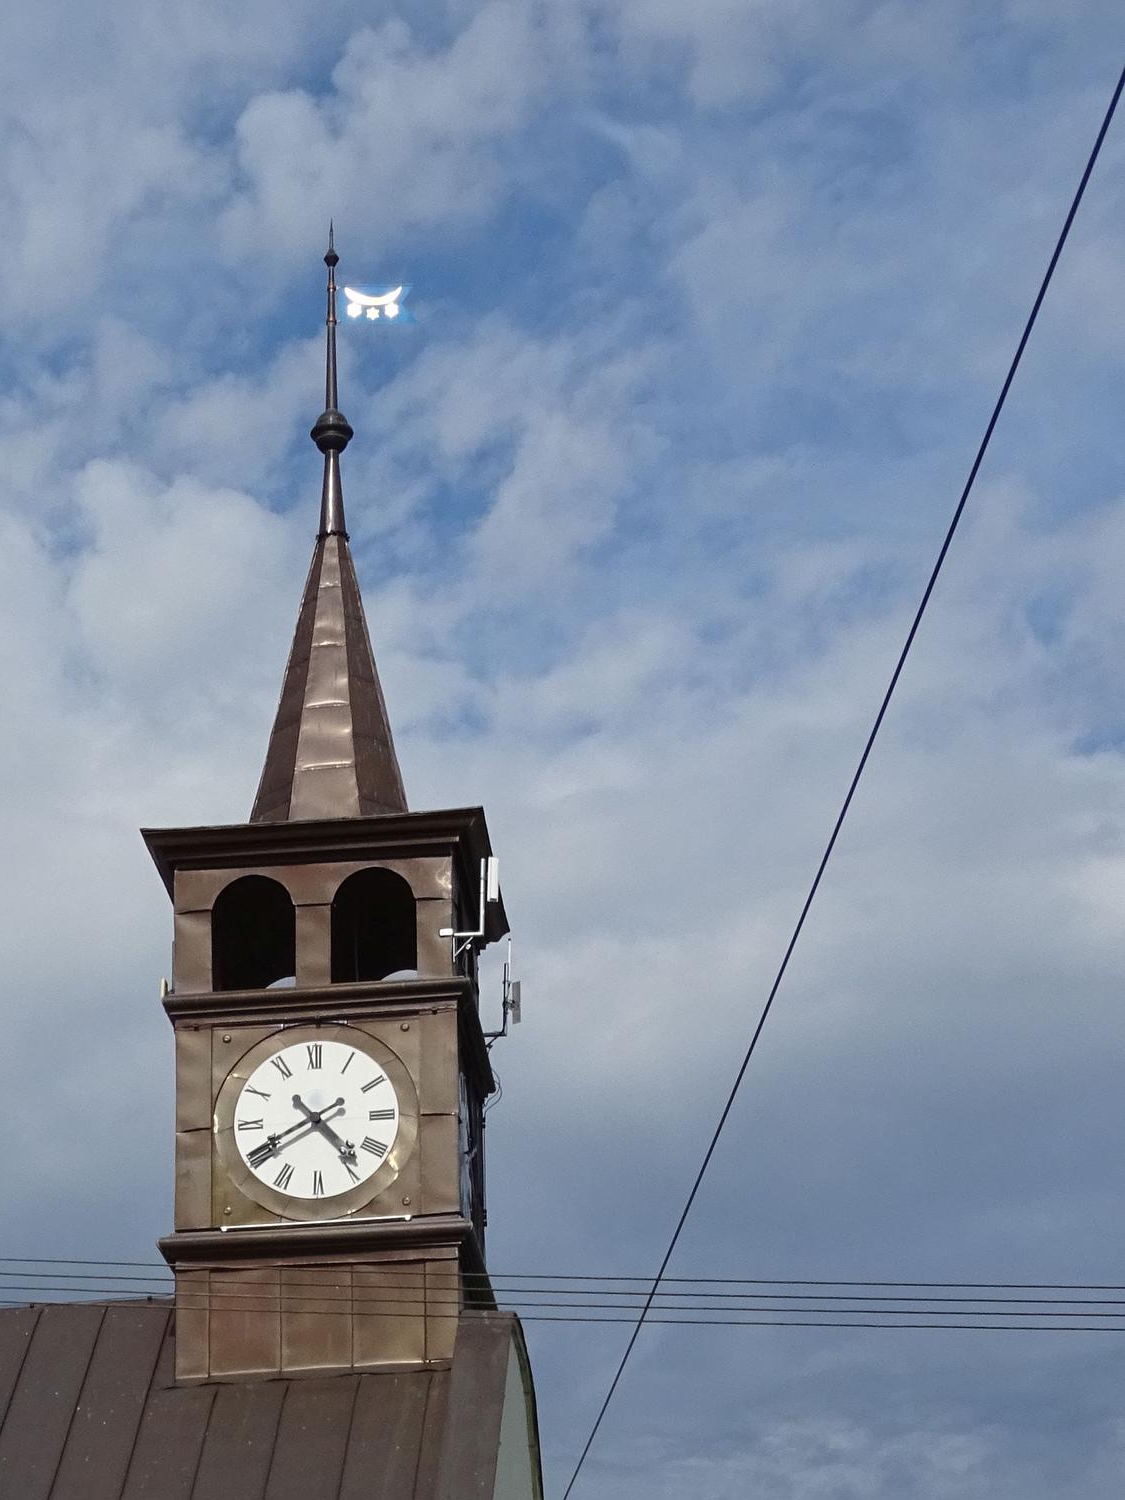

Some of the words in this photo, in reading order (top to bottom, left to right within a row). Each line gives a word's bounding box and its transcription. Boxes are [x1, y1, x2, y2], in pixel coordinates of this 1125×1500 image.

[307, 1044, 322, 1070] XII
[341, 1052, 355, 1074] I
[270, 1055, 293, 1081] XI
[245, 1085, 271, 1101] X
[361, 1075, 387, 1093] II
[369, 1109, 395, 1120] III
[238, 1119, 263, 1130] IX
